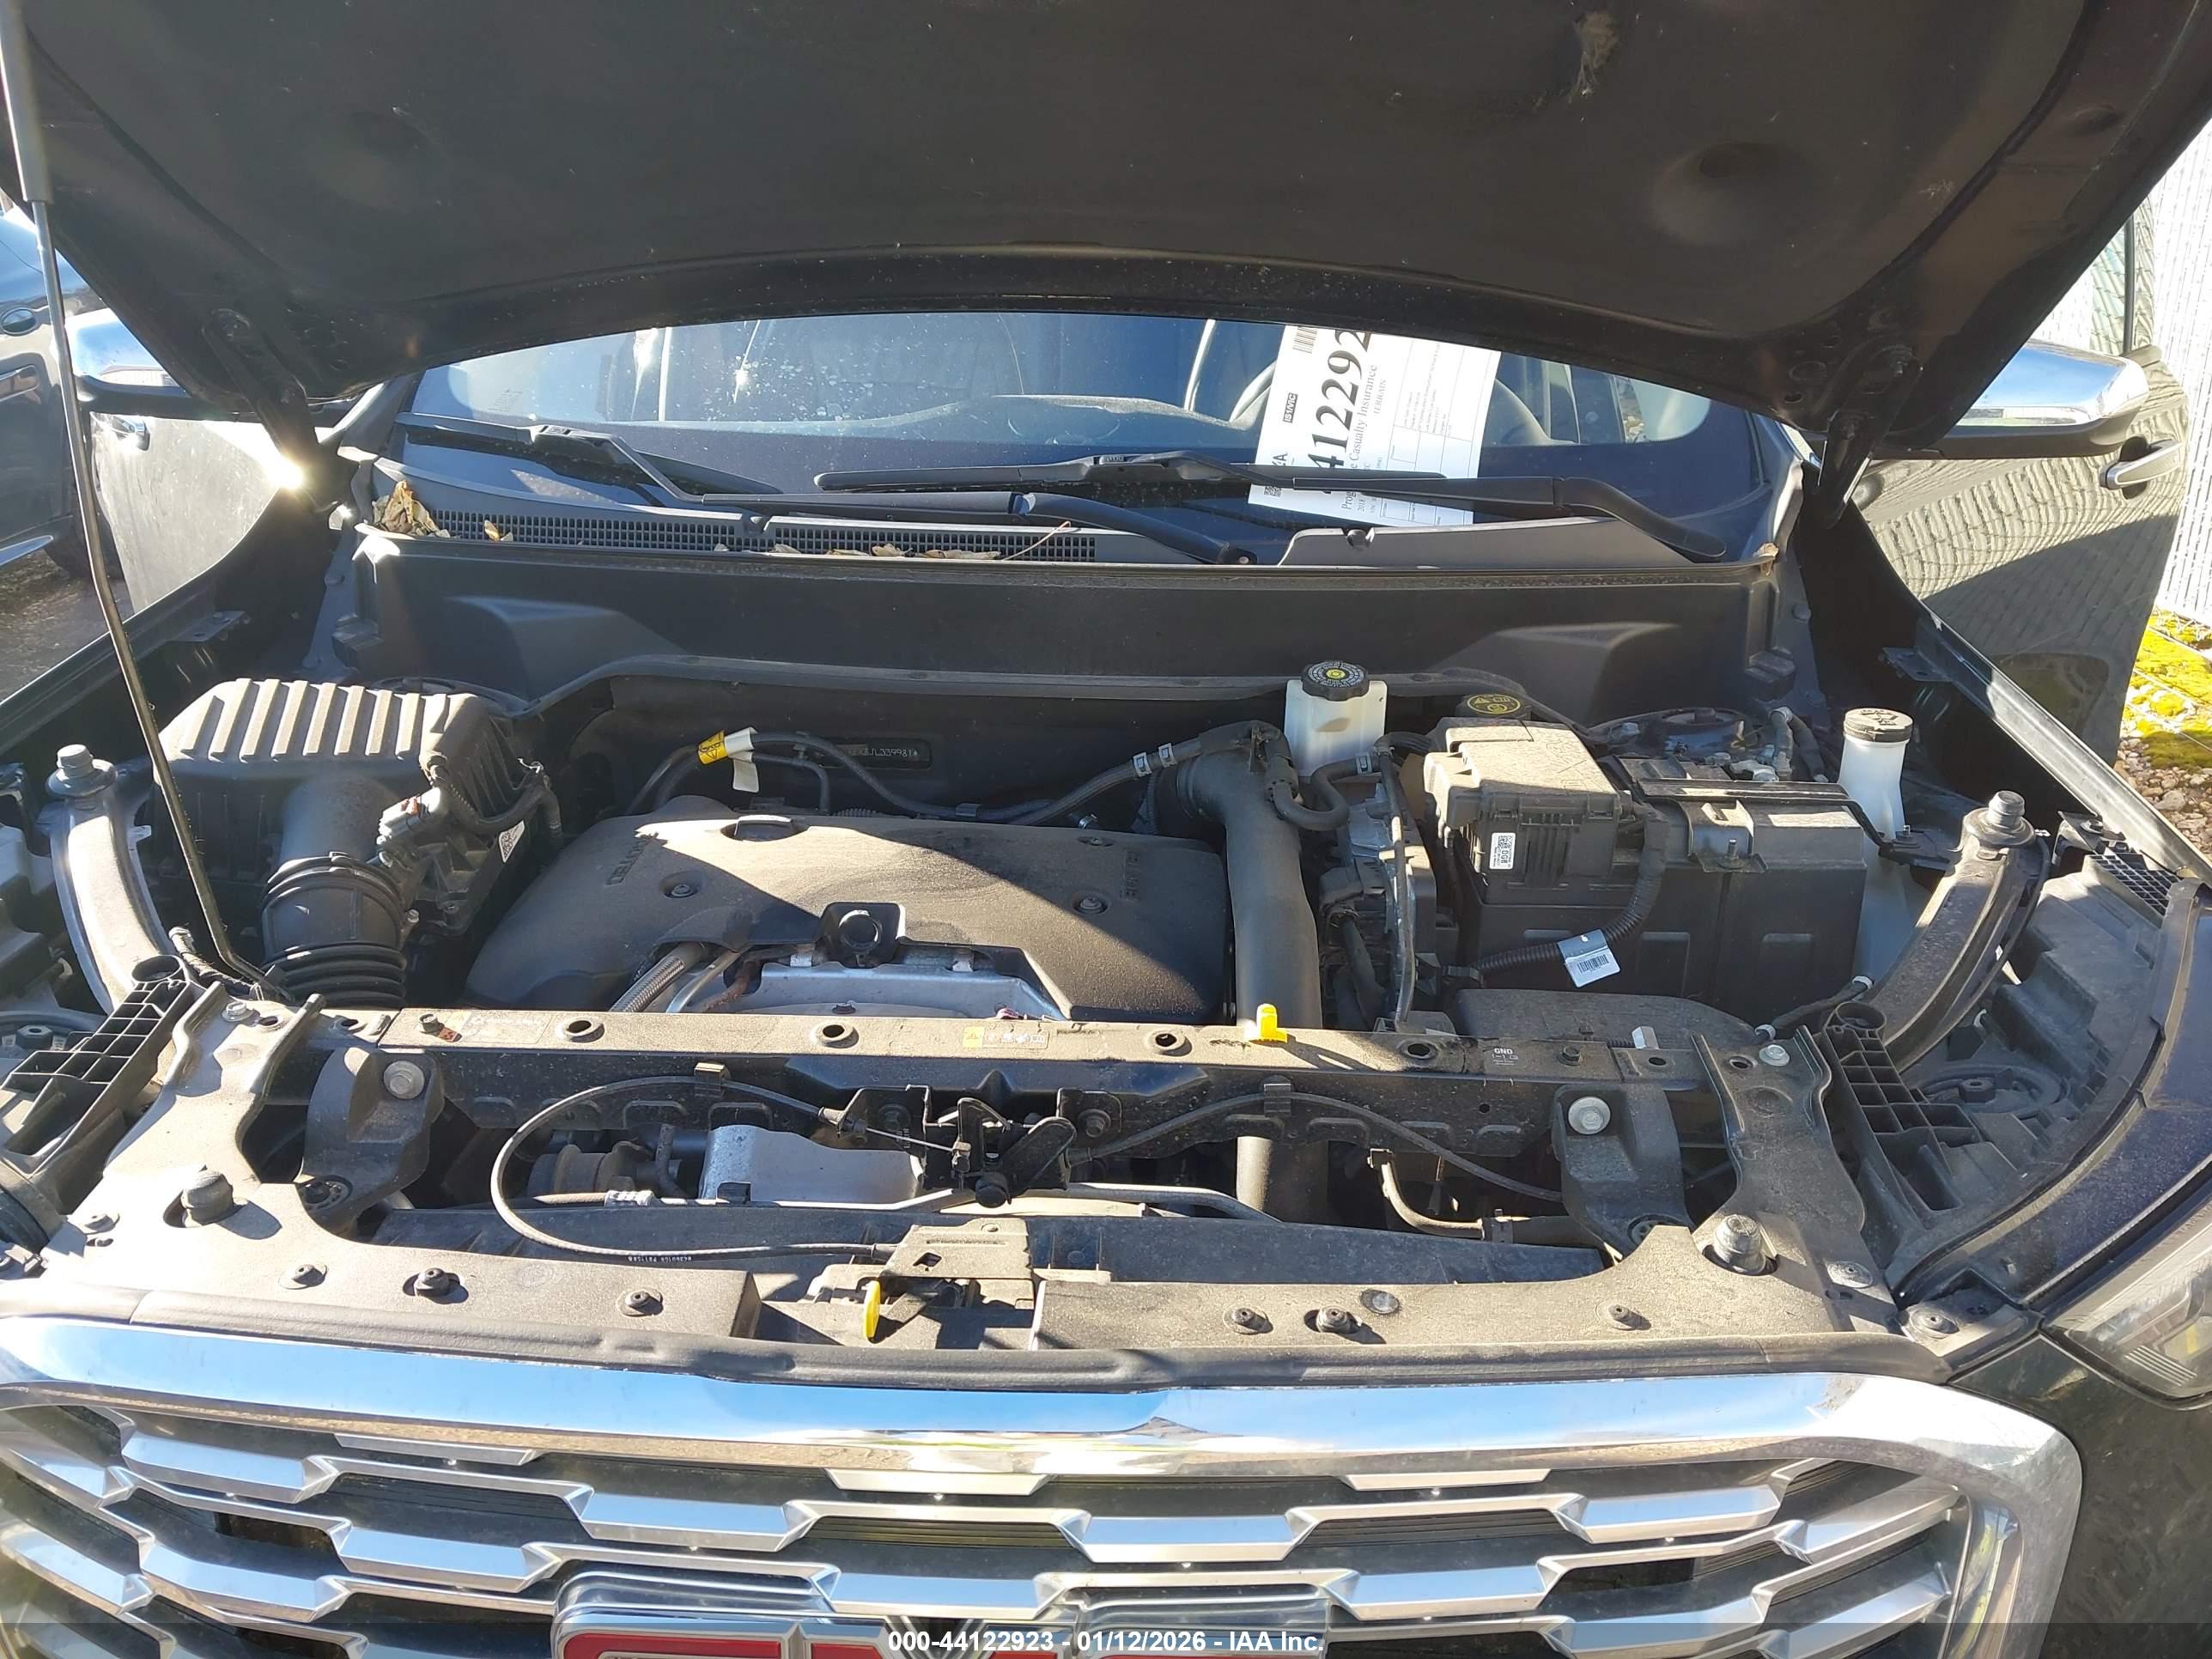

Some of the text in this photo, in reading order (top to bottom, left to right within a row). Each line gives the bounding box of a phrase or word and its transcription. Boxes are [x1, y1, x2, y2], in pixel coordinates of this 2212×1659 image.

[1307, 330, 1372, 495] 412292
[1357, 364, 1377, 419] Insurance
[1373, 379, 1388, 414] TERRAIN
[1349, 419, 1368, 461] Casualty
